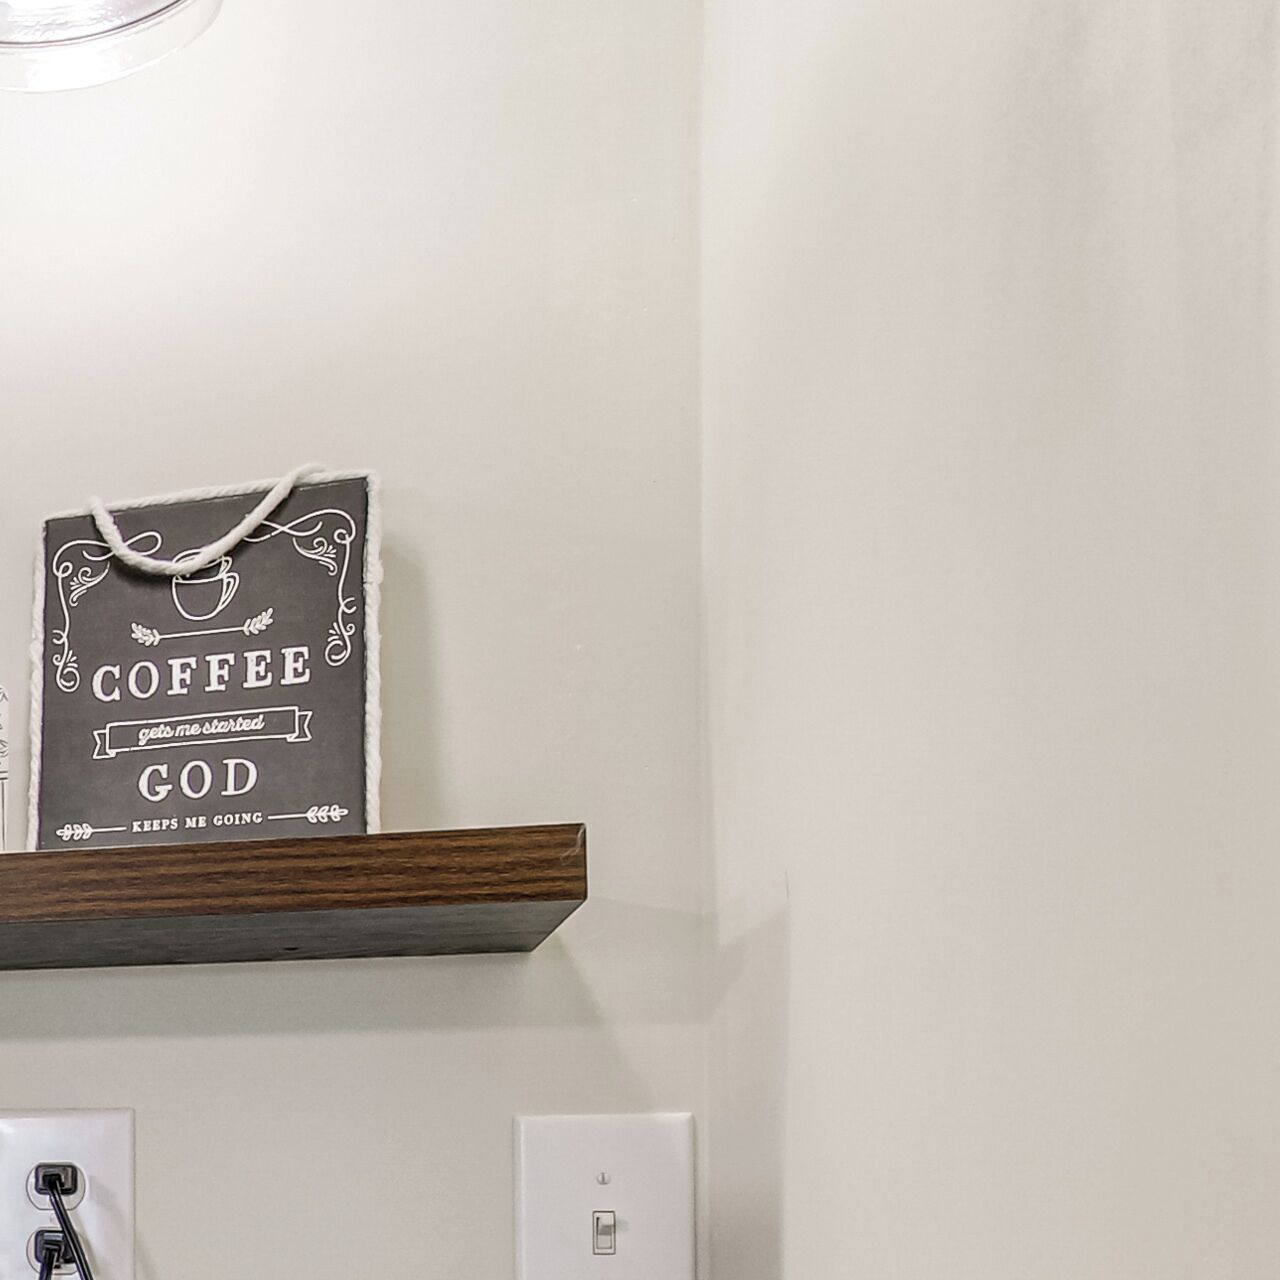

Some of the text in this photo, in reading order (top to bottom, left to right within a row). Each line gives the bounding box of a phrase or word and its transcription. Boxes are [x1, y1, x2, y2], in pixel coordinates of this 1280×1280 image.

[92, 646, 311, 702] COFFEE
[138, 714, 265, 746] gets me started
[138, 758, 258, 802] GOD
[132, 812, 262, 832] KEEPS ME GOING
